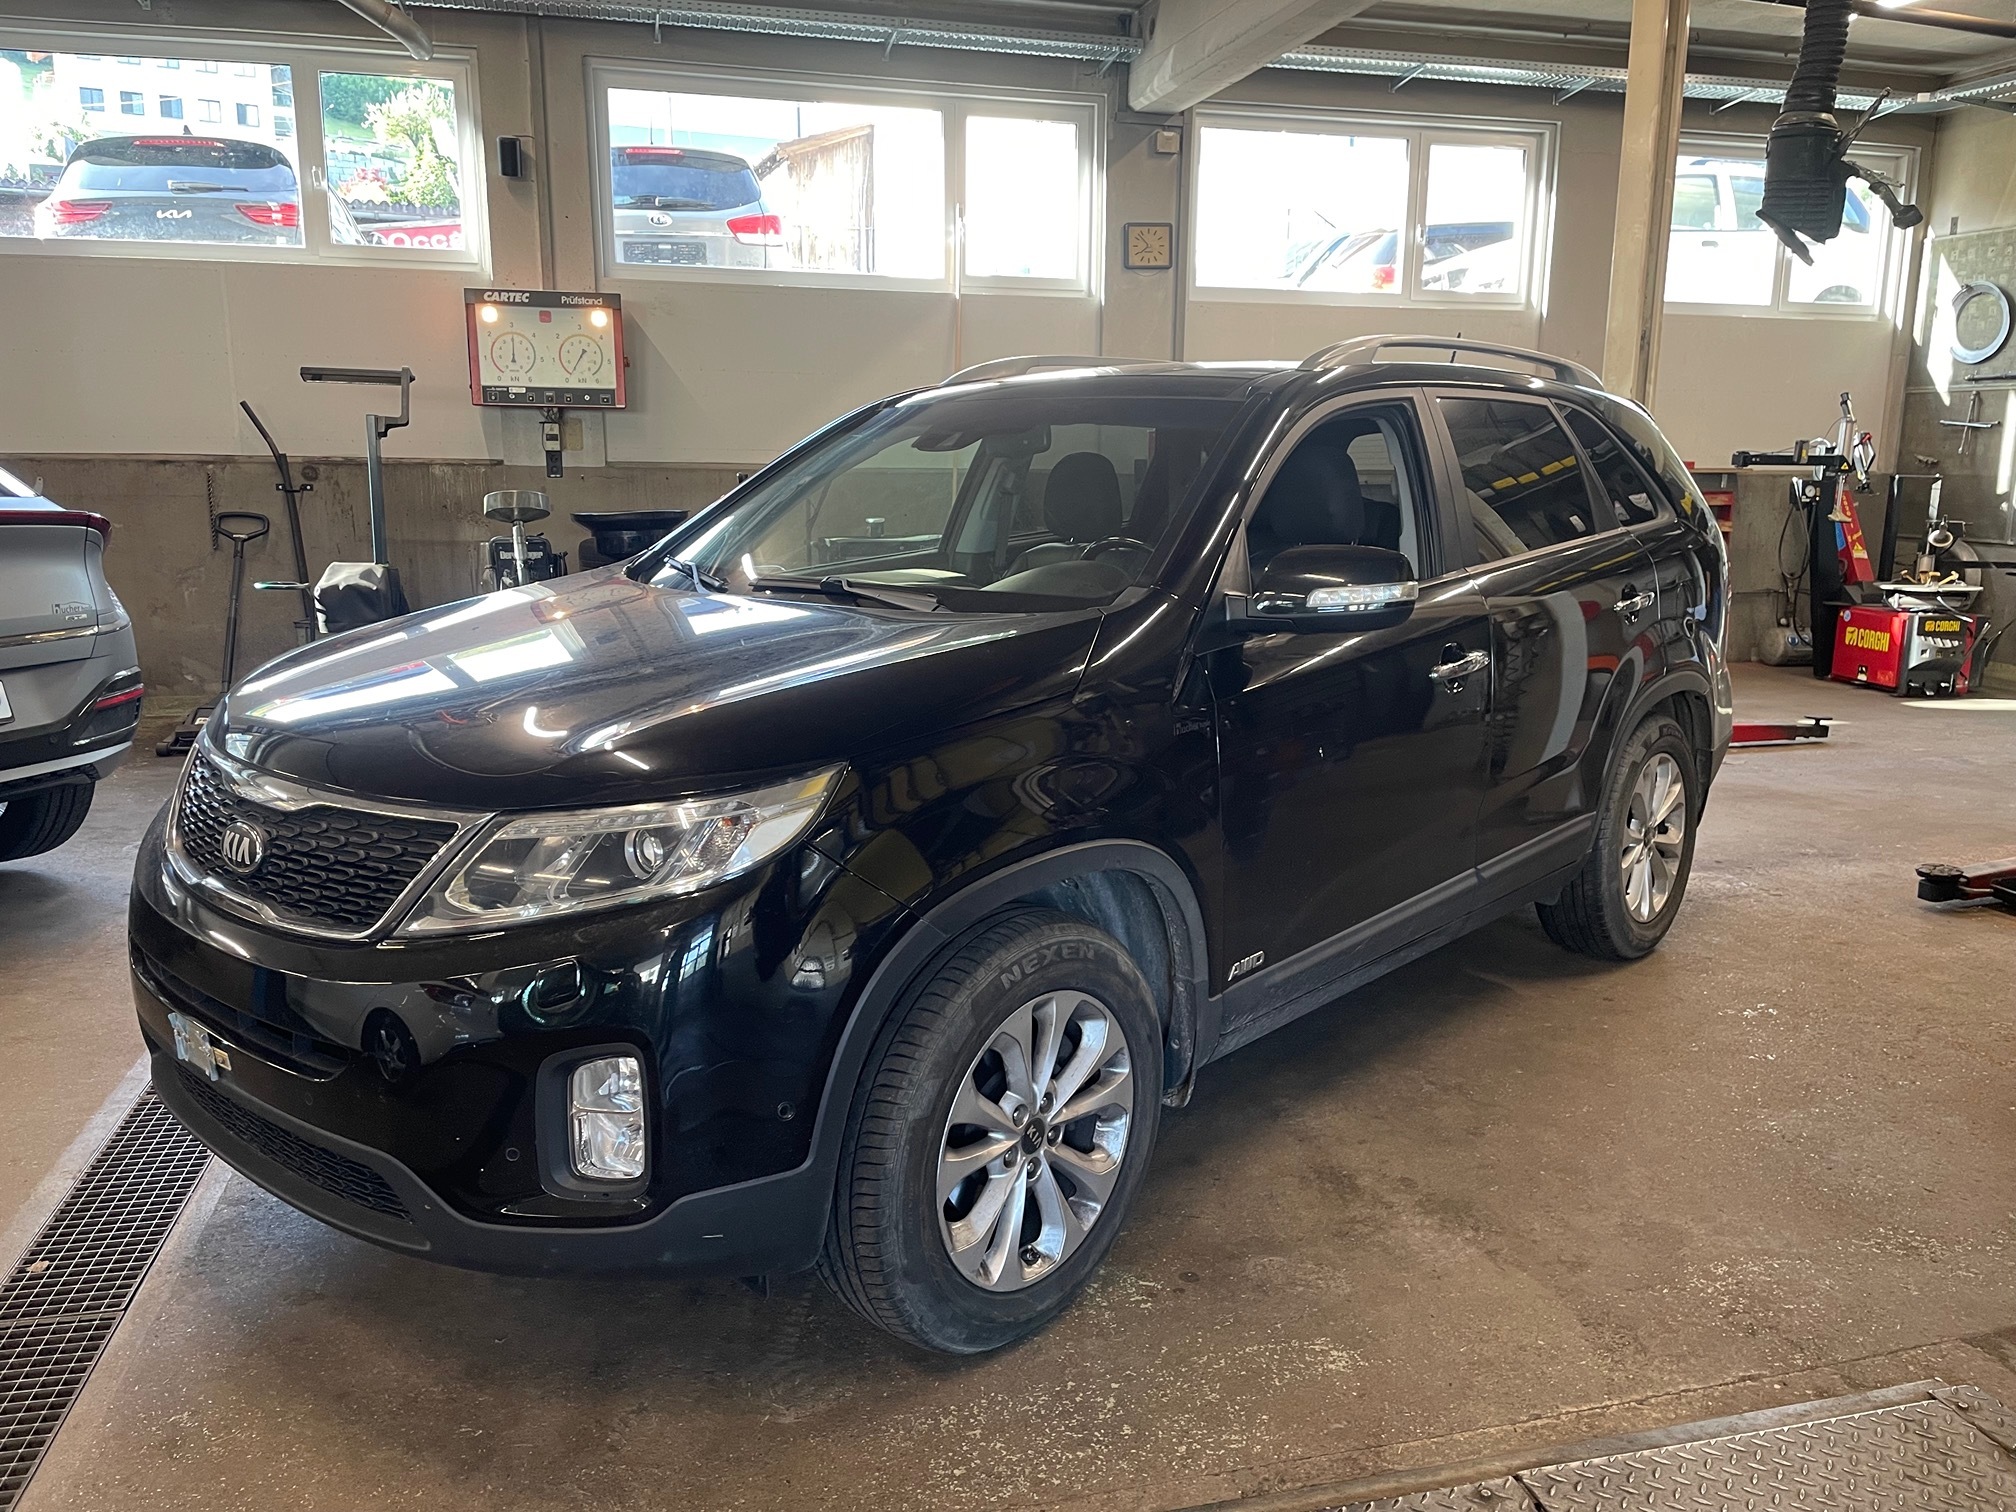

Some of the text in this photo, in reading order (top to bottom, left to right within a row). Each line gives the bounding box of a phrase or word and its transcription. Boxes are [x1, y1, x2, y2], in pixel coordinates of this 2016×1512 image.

[483, 291, 530, 303] CARTEC
[561, 295, 603, 306] Prüfstand
[1935, 620, 1961, 632] CORGHI
[1858, 629, 1890, 652] CORGHI
[223, 830, 250, 865] KIA
[1000, 943, 1096, 990] NEXEN
[1026, 1124, 1042, 1149] KIA
